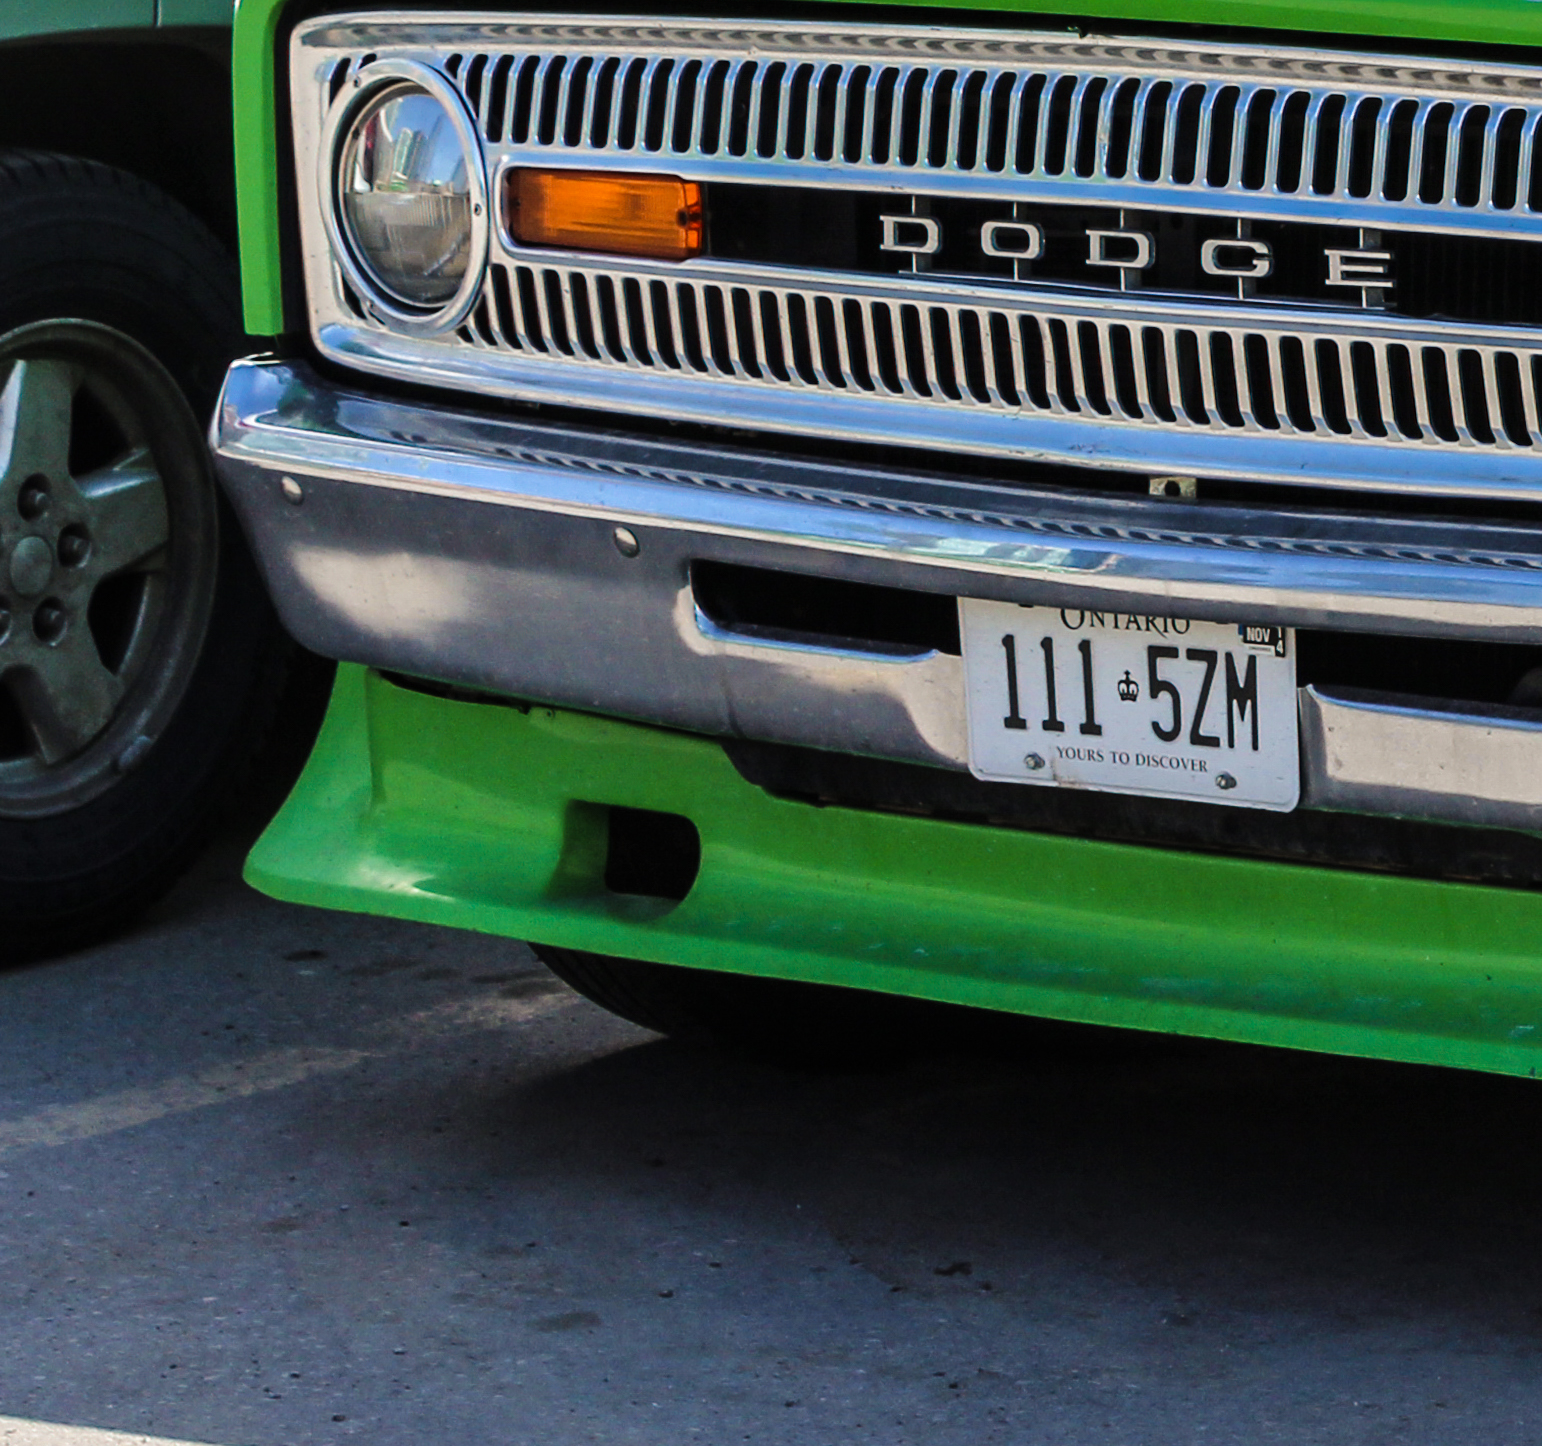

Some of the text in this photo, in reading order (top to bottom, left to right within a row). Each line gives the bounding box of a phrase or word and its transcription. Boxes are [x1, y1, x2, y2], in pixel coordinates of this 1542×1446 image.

[880, 214, 1395, 288] DODGE
[1246, 626, 1271, 643] NOV
[1001, 634, 1259, 751] 111 5ZM
[1056, 745, 1208, 773] YOURS TO DISCOVER
